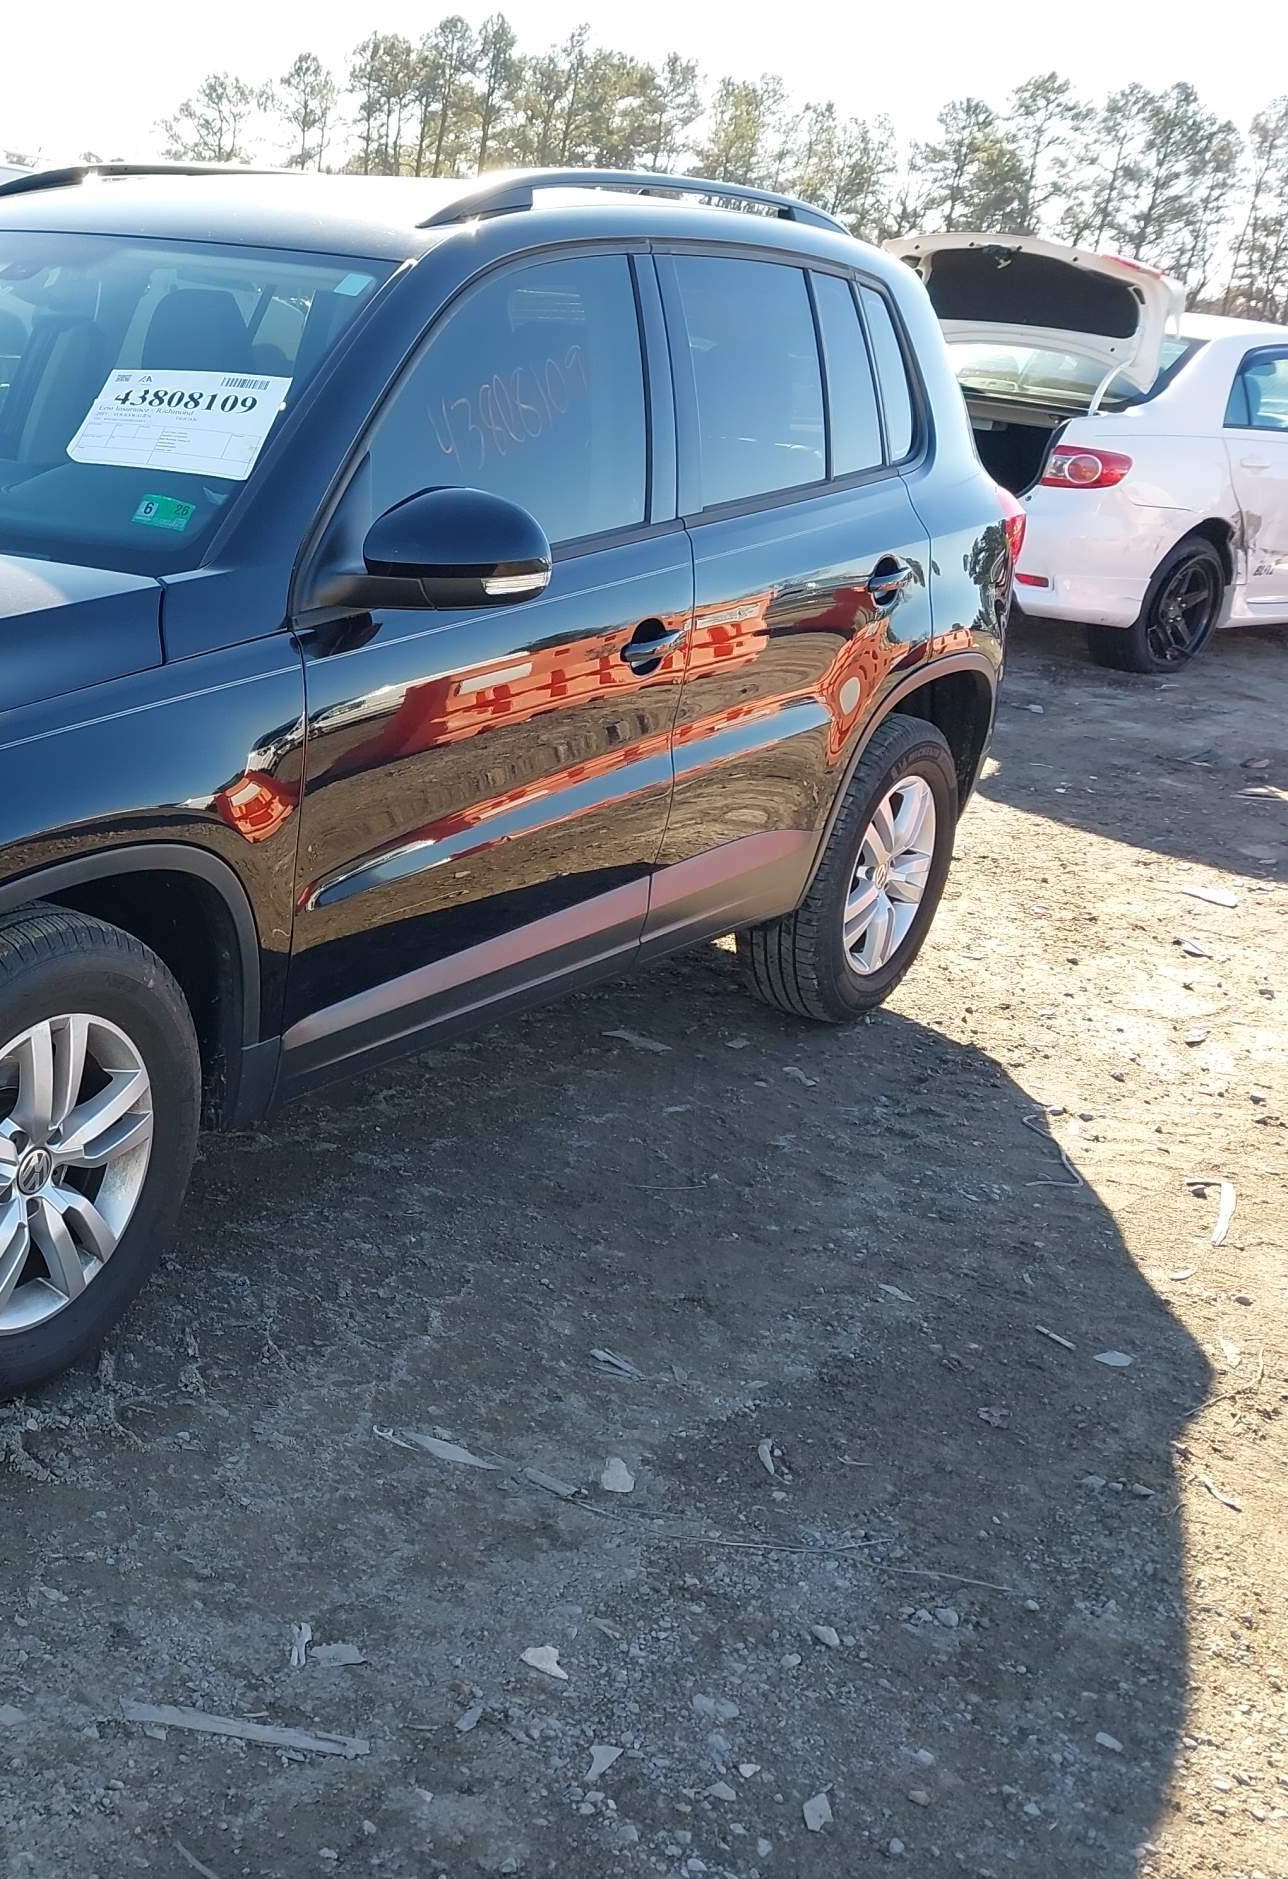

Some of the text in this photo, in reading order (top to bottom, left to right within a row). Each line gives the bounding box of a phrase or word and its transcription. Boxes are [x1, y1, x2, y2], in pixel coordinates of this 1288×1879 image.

[114, 389, 258, 414] 43808109
[143, 502, 155, 515] 6
[174, 504, 191, 516] 26
